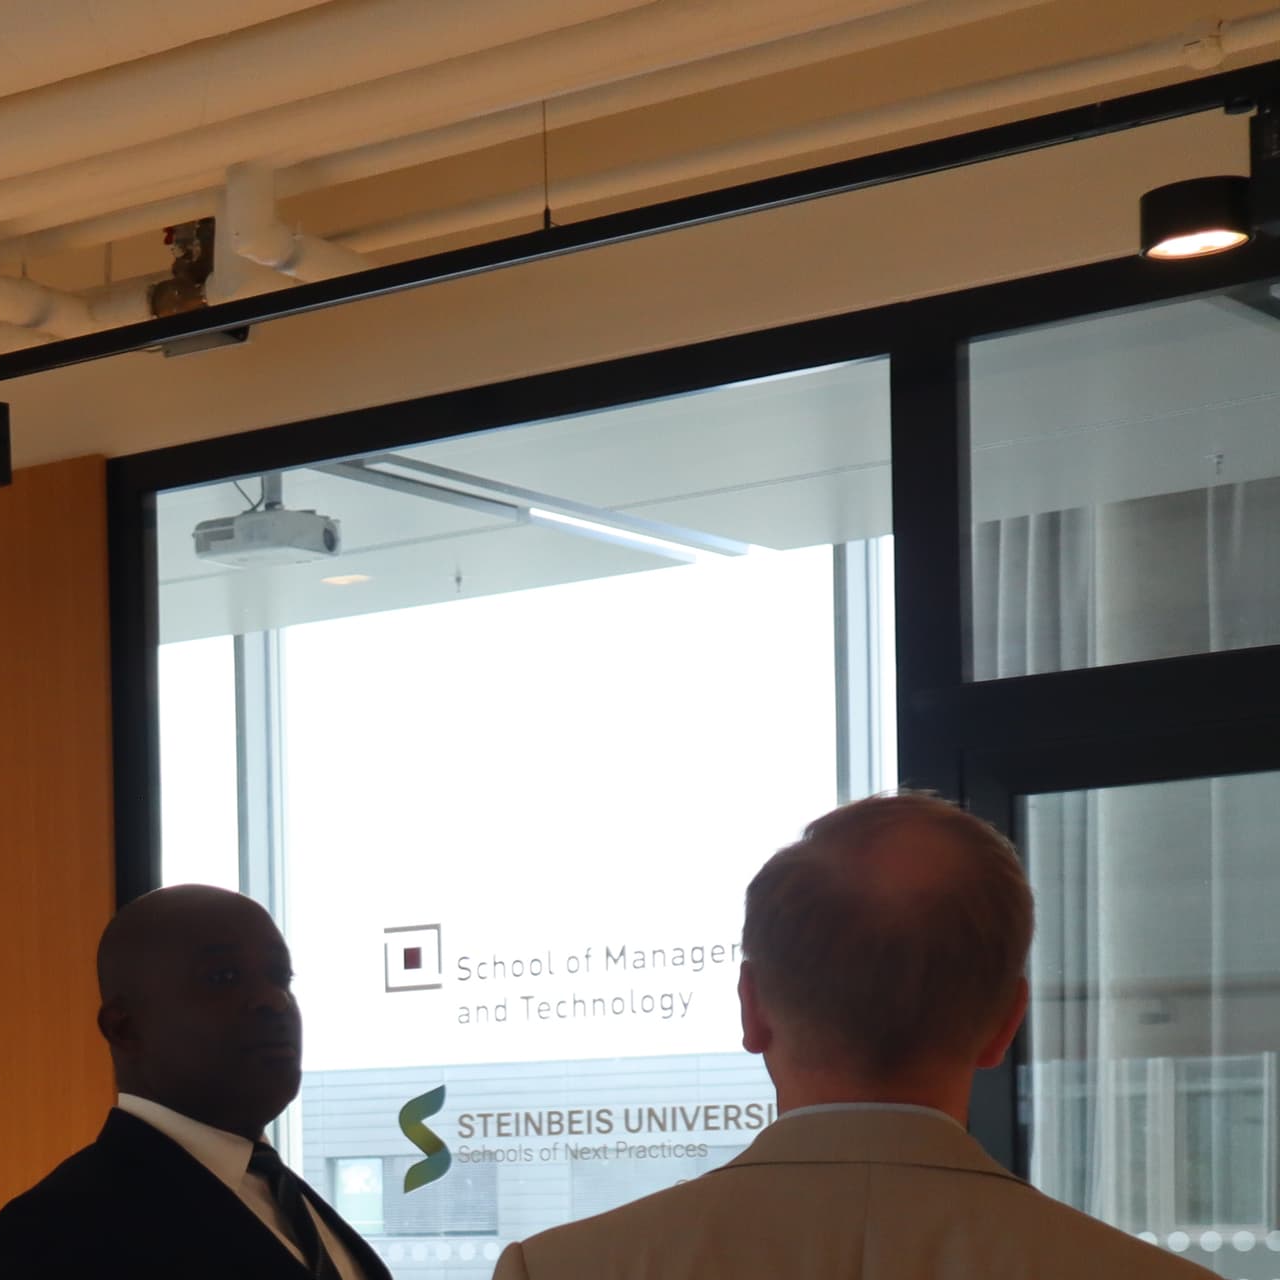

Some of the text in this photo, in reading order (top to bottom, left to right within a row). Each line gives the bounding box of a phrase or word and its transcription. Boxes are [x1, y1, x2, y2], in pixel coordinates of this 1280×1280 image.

[457, 949, 554, 982] School
[567, 947, 593, 974] of
[457, 988, 694, 1025] and Technology
[457, 1103, 778, 1140] STEINBEIS UNIVERSI
[457, 1139, 709, 1165] Schools of Next Practices
